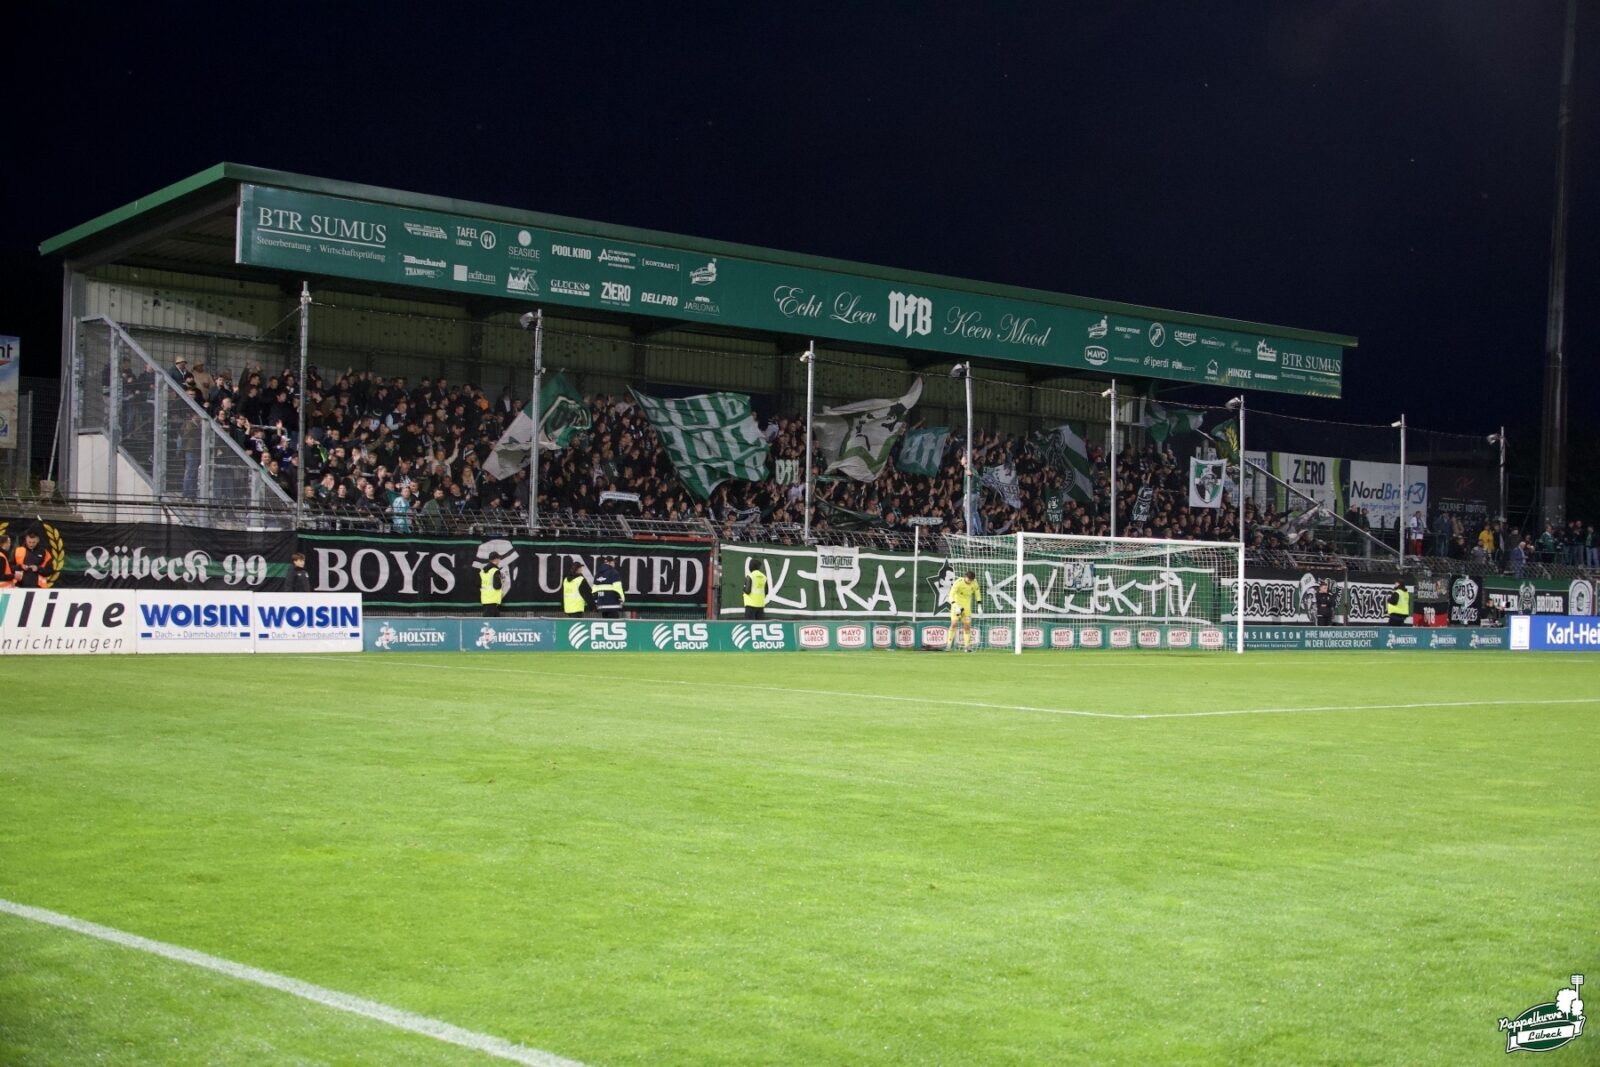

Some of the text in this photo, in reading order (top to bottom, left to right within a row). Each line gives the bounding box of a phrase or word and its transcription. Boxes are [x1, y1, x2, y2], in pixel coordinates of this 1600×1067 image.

[258, 207, 303, 231] BTR
[310, 215, 387, 243] SUMUS
[456, 226, 478, 239] TAFEL
[256, 235, 386, 262] Steuerberatung Wirtschaftsprüfung
[508, 246, 541, 259] SEASIDE
[551, 244, 592, 260] POOLKIND
[641, 292, 678, 307] DELLPRO
[774, 285, 824, 318] Echt
[829, 291, 877, 325] Leev
[944, 306, 993, 341] Keen
[997, 313, 1051, 347] Mood
[1087, 349, 1106, 360] MAYO
[1282, 352, 1302, 368] BTR
[1305, 355, 1341, 373] SUMUS
[1227, 368, 1251, 379] HINZKE
[1351, 481, 1413, 500] NordBrif
[223, 553, 268, 586] 99
[314, 547, 456, 595] BOYS
[140, 604, 250, 628] WOISIN
[258, 605, 360, 628] WOISIN
[399, 631, 446, 643] HOLSTEN
[498, 631, 542, 643] HOLSTEN
[590, 622, 628, 641] FLS
[673, 622, 709, 641] FLS
[751, 623, 785, 641] FLS
[1228, 631, 1300, 640] KNSINGTON
[1305, 630, 1318, 638] IHRE
[590, 641, 627, 650] GROUP
[673, 641, 709, 650] GROUP
[752, 641, 785, 649] GROUP
[1304, 639, 1312, 647] IN
[1312, 639, 1327, 648] DER
[1327, 638, 1352, 648] LÜBECKER
